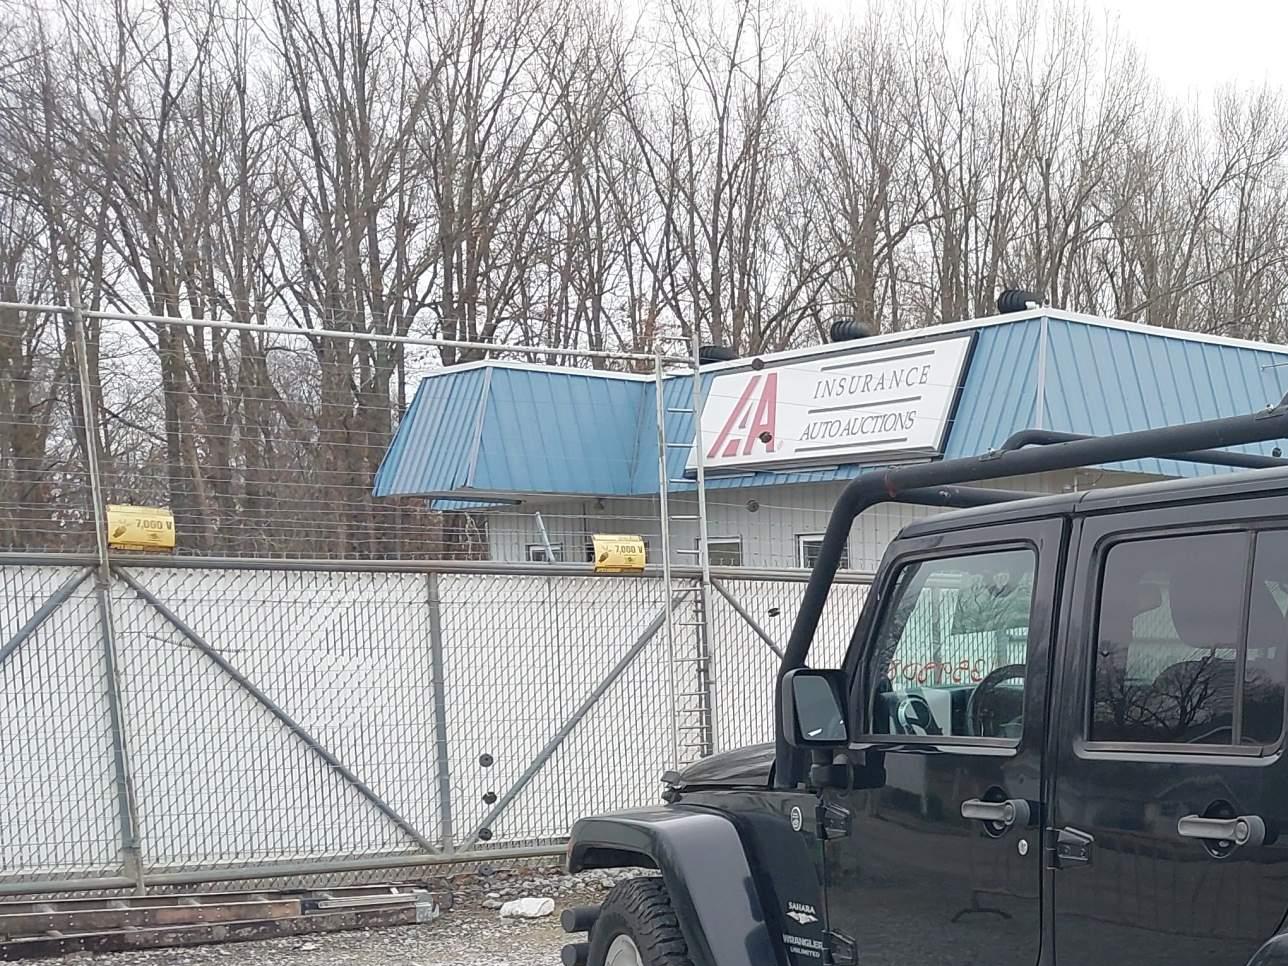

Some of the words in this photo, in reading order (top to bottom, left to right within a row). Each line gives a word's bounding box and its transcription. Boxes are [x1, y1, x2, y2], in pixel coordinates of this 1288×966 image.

[814, 364, 931, 399] INSURANCE
[788, 901, 816, 915] SAHARA
[782, 933, 824, 951] WRANGLER
